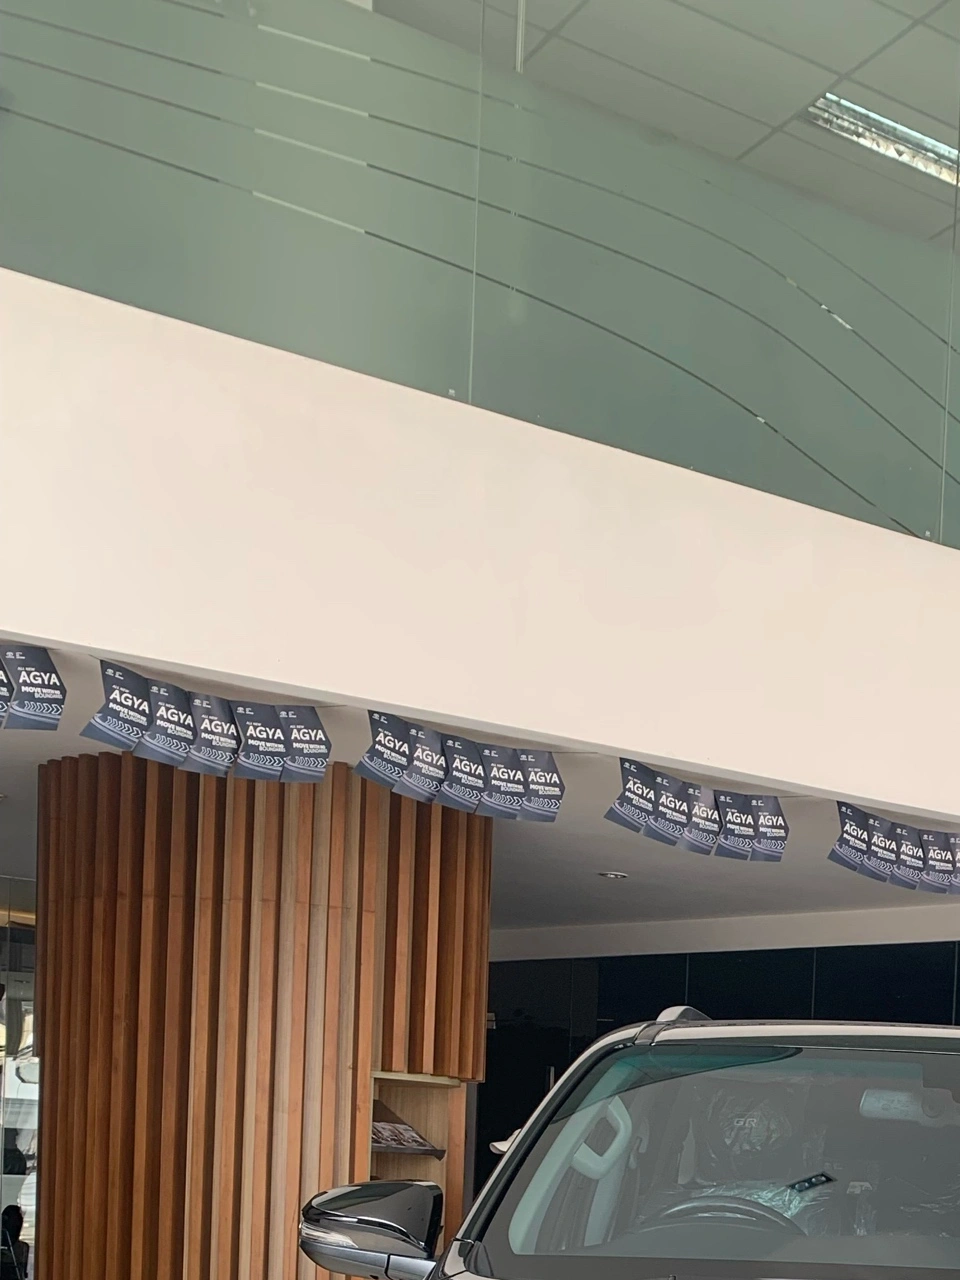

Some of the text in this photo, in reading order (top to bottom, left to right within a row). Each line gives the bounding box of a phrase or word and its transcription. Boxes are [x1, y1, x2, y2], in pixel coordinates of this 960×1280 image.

[19, 671, 60, 686] AGYA
[109, 689, 149, 714] AGYA
[156, 707, 194, 728] AGYA
[200, 719, 237, 736] AGYA
[246, 726, 284, 740] AGYA
[291, 728, 326, 740] AGYA
[376, 732, 409, 755] AGYA
[414, 748, 446, 767] AGYA
[453, 758, 484, 776] AGYA
[491, 767, 523, 781] AGYA
[529, 772, 560, 784] AGYA
[626, 780, 654, 801] AGYA
[659, 794, 688, 813] AGYA
[692, 805, 719, 821] AGYA
[726, 812, 754, 825] AGYA
[758, 815, 784, 826] AGYA
[844, 823, 868, 841] AGYA
[872, 835, 897, 851] AGYA
[900, 844, 924, 858] AGYA
[928, 849, 952, 861] AGYA
